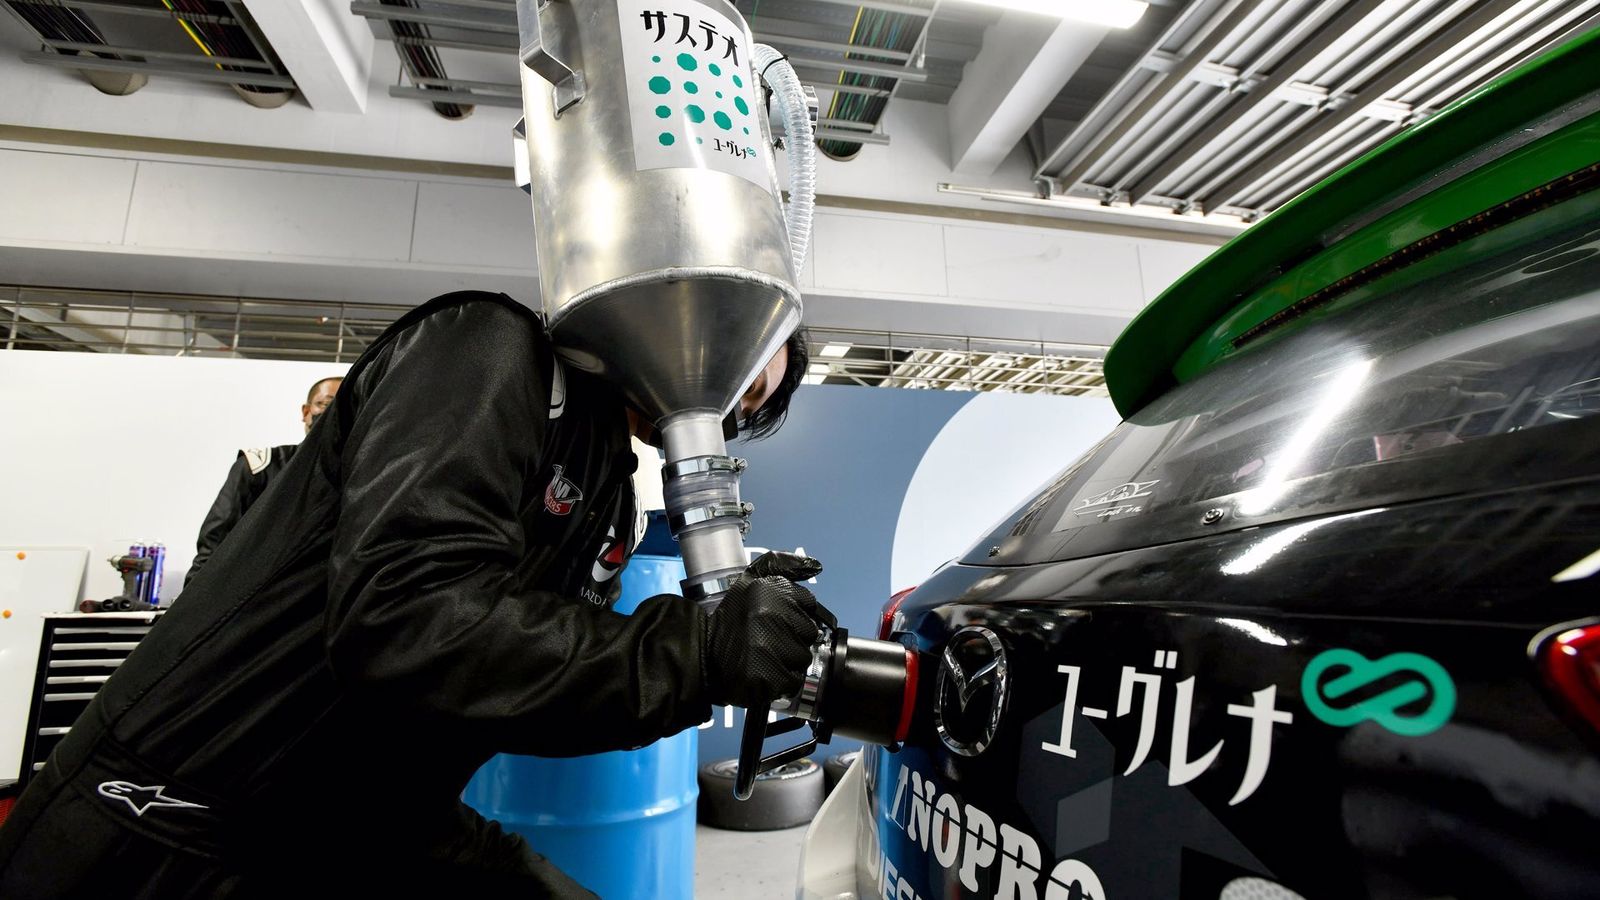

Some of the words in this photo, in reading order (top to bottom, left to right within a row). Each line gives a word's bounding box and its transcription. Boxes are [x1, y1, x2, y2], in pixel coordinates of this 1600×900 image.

[640, 10, 739, 67] サステオ
[713, 138, 747, 159] ユーグレナ
[1041, 650, 1293, 806] ユーグレナ
